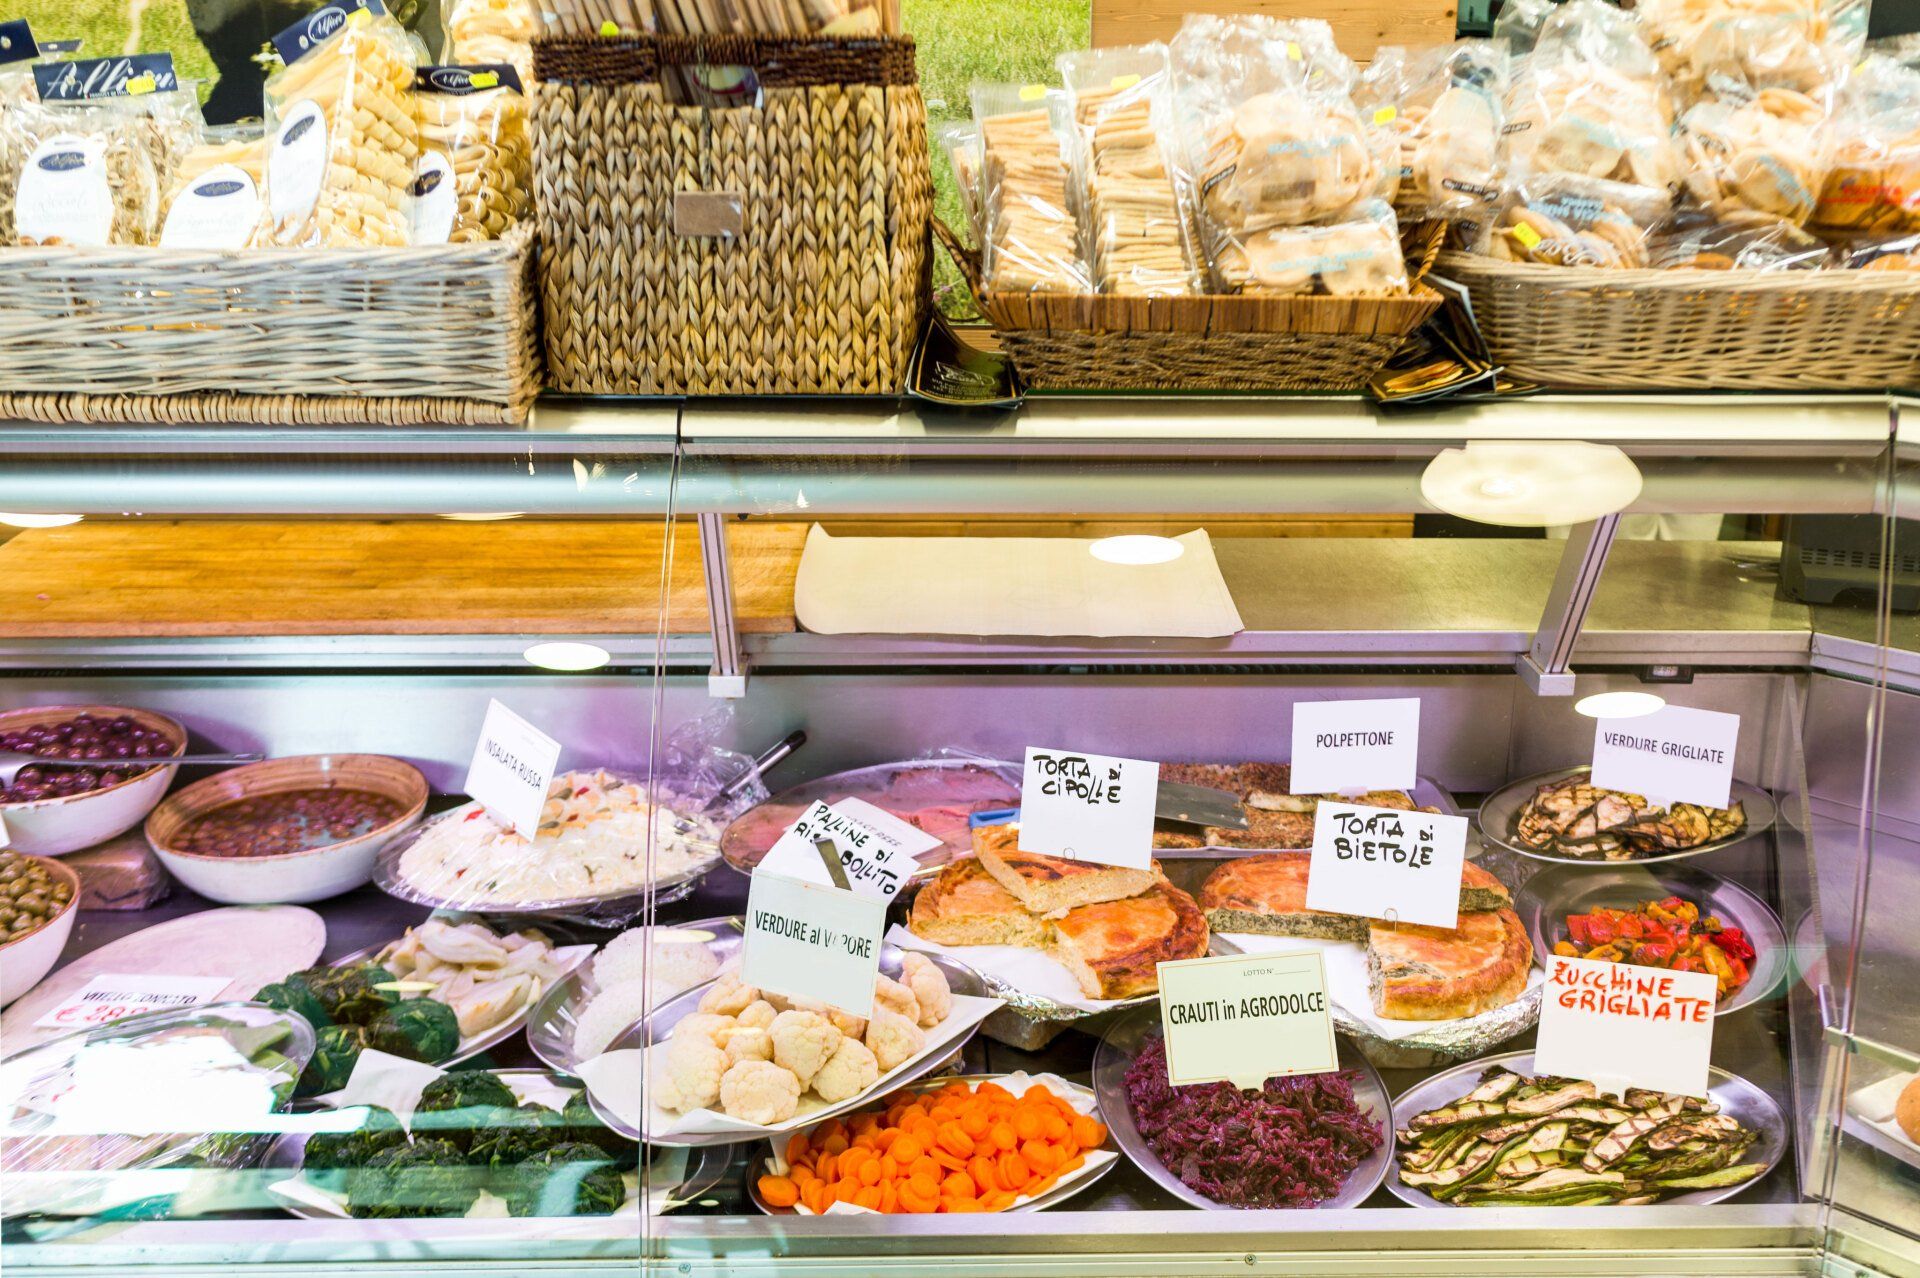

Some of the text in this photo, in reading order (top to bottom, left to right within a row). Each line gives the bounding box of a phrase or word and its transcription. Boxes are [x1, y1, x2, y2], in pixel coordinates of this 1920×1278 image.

[1316, 731, 1394, 748] POLPETTONE
[1604, 731, 1724, 764] VERDURE GRIGLIATE
[485, 738, 543, 790] INSALATA RUSSA
[1033, 755, 1090, 779] TORTA
[1333, 813, 1404, 838] TORTA
[755, 910, 808, 942] VERDURE
[809, 927, 821, 947] al
[1243, 969, 1266, 977] LOTTO
[1170, 992, 1324, 1025] CRAUTI in AGRODOLCE
